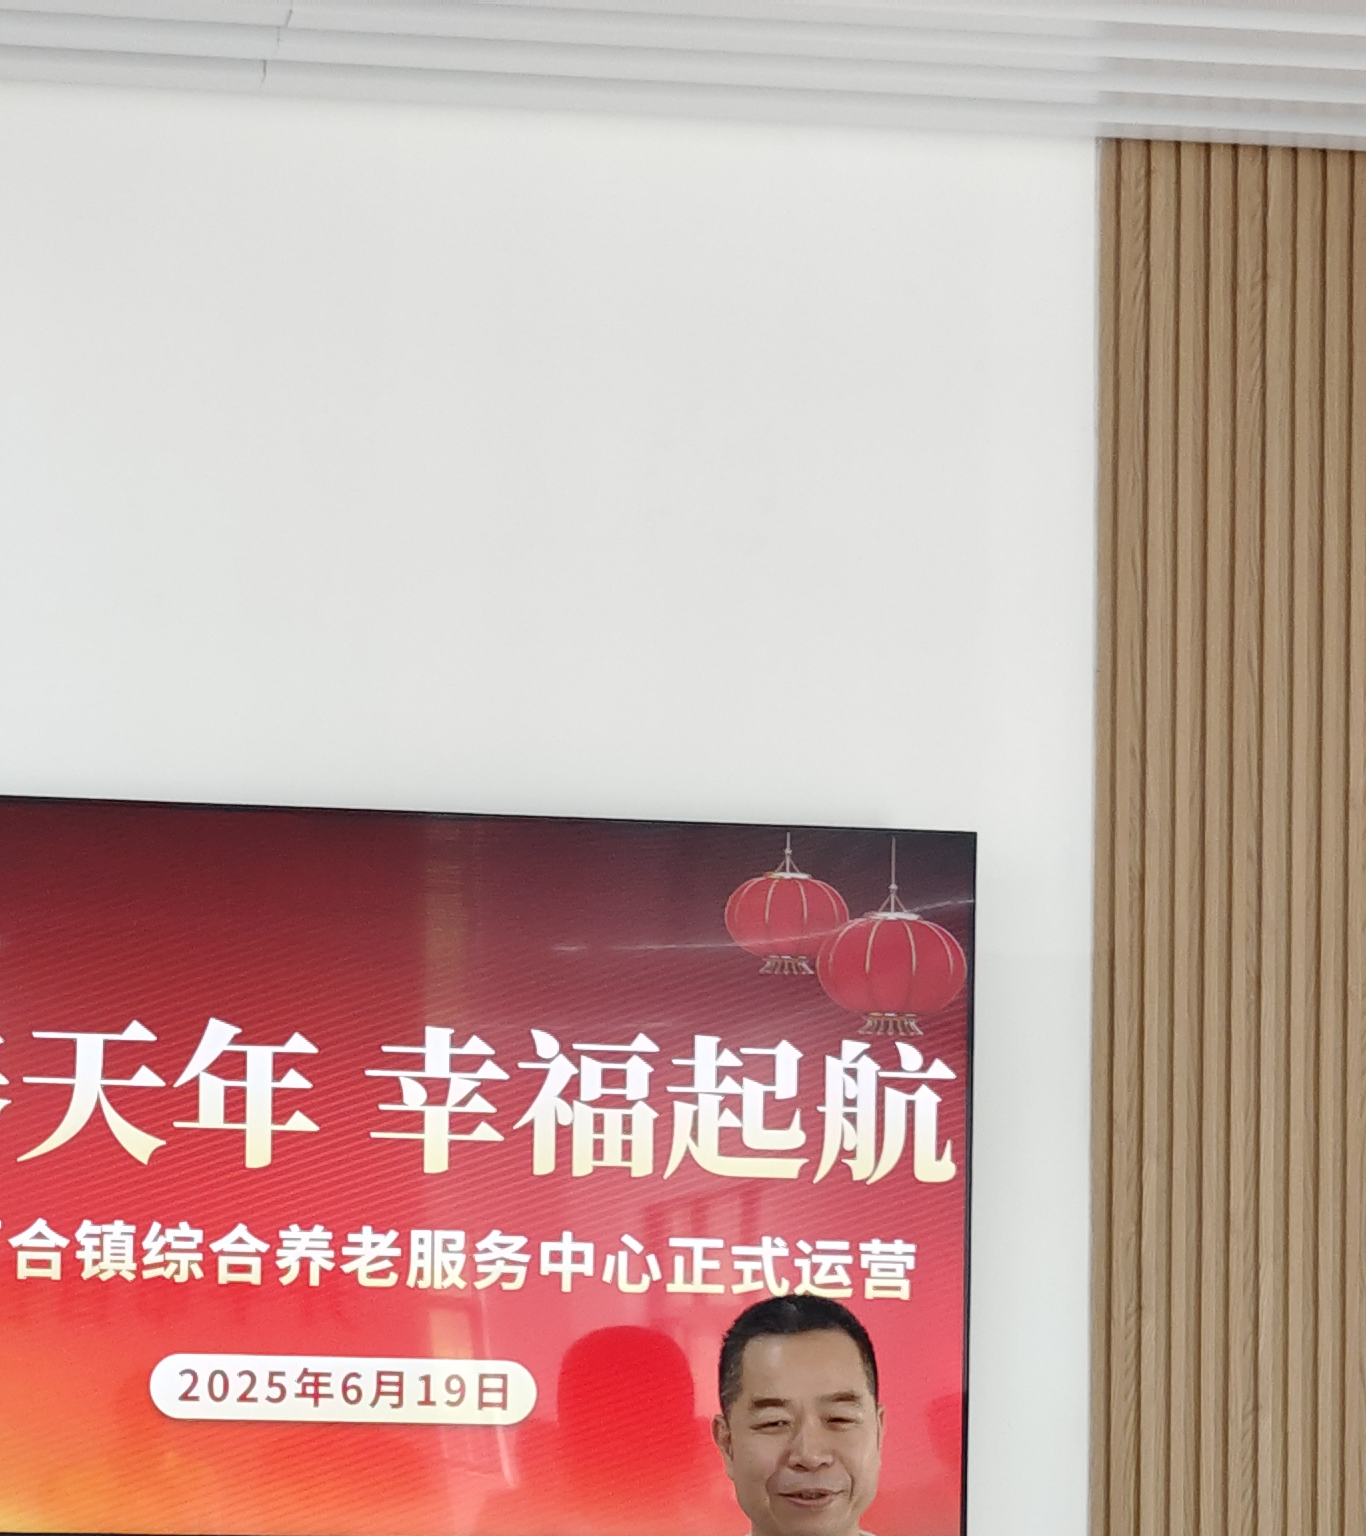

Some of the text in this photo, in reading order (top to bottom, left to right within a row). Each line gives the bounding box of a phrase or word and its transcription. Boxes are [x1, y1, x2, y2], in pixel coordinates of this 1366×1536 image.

[364, 1024, 958, 1185] 幸福起航
[178, 1365, 512, 1414] 2025年6月19日
